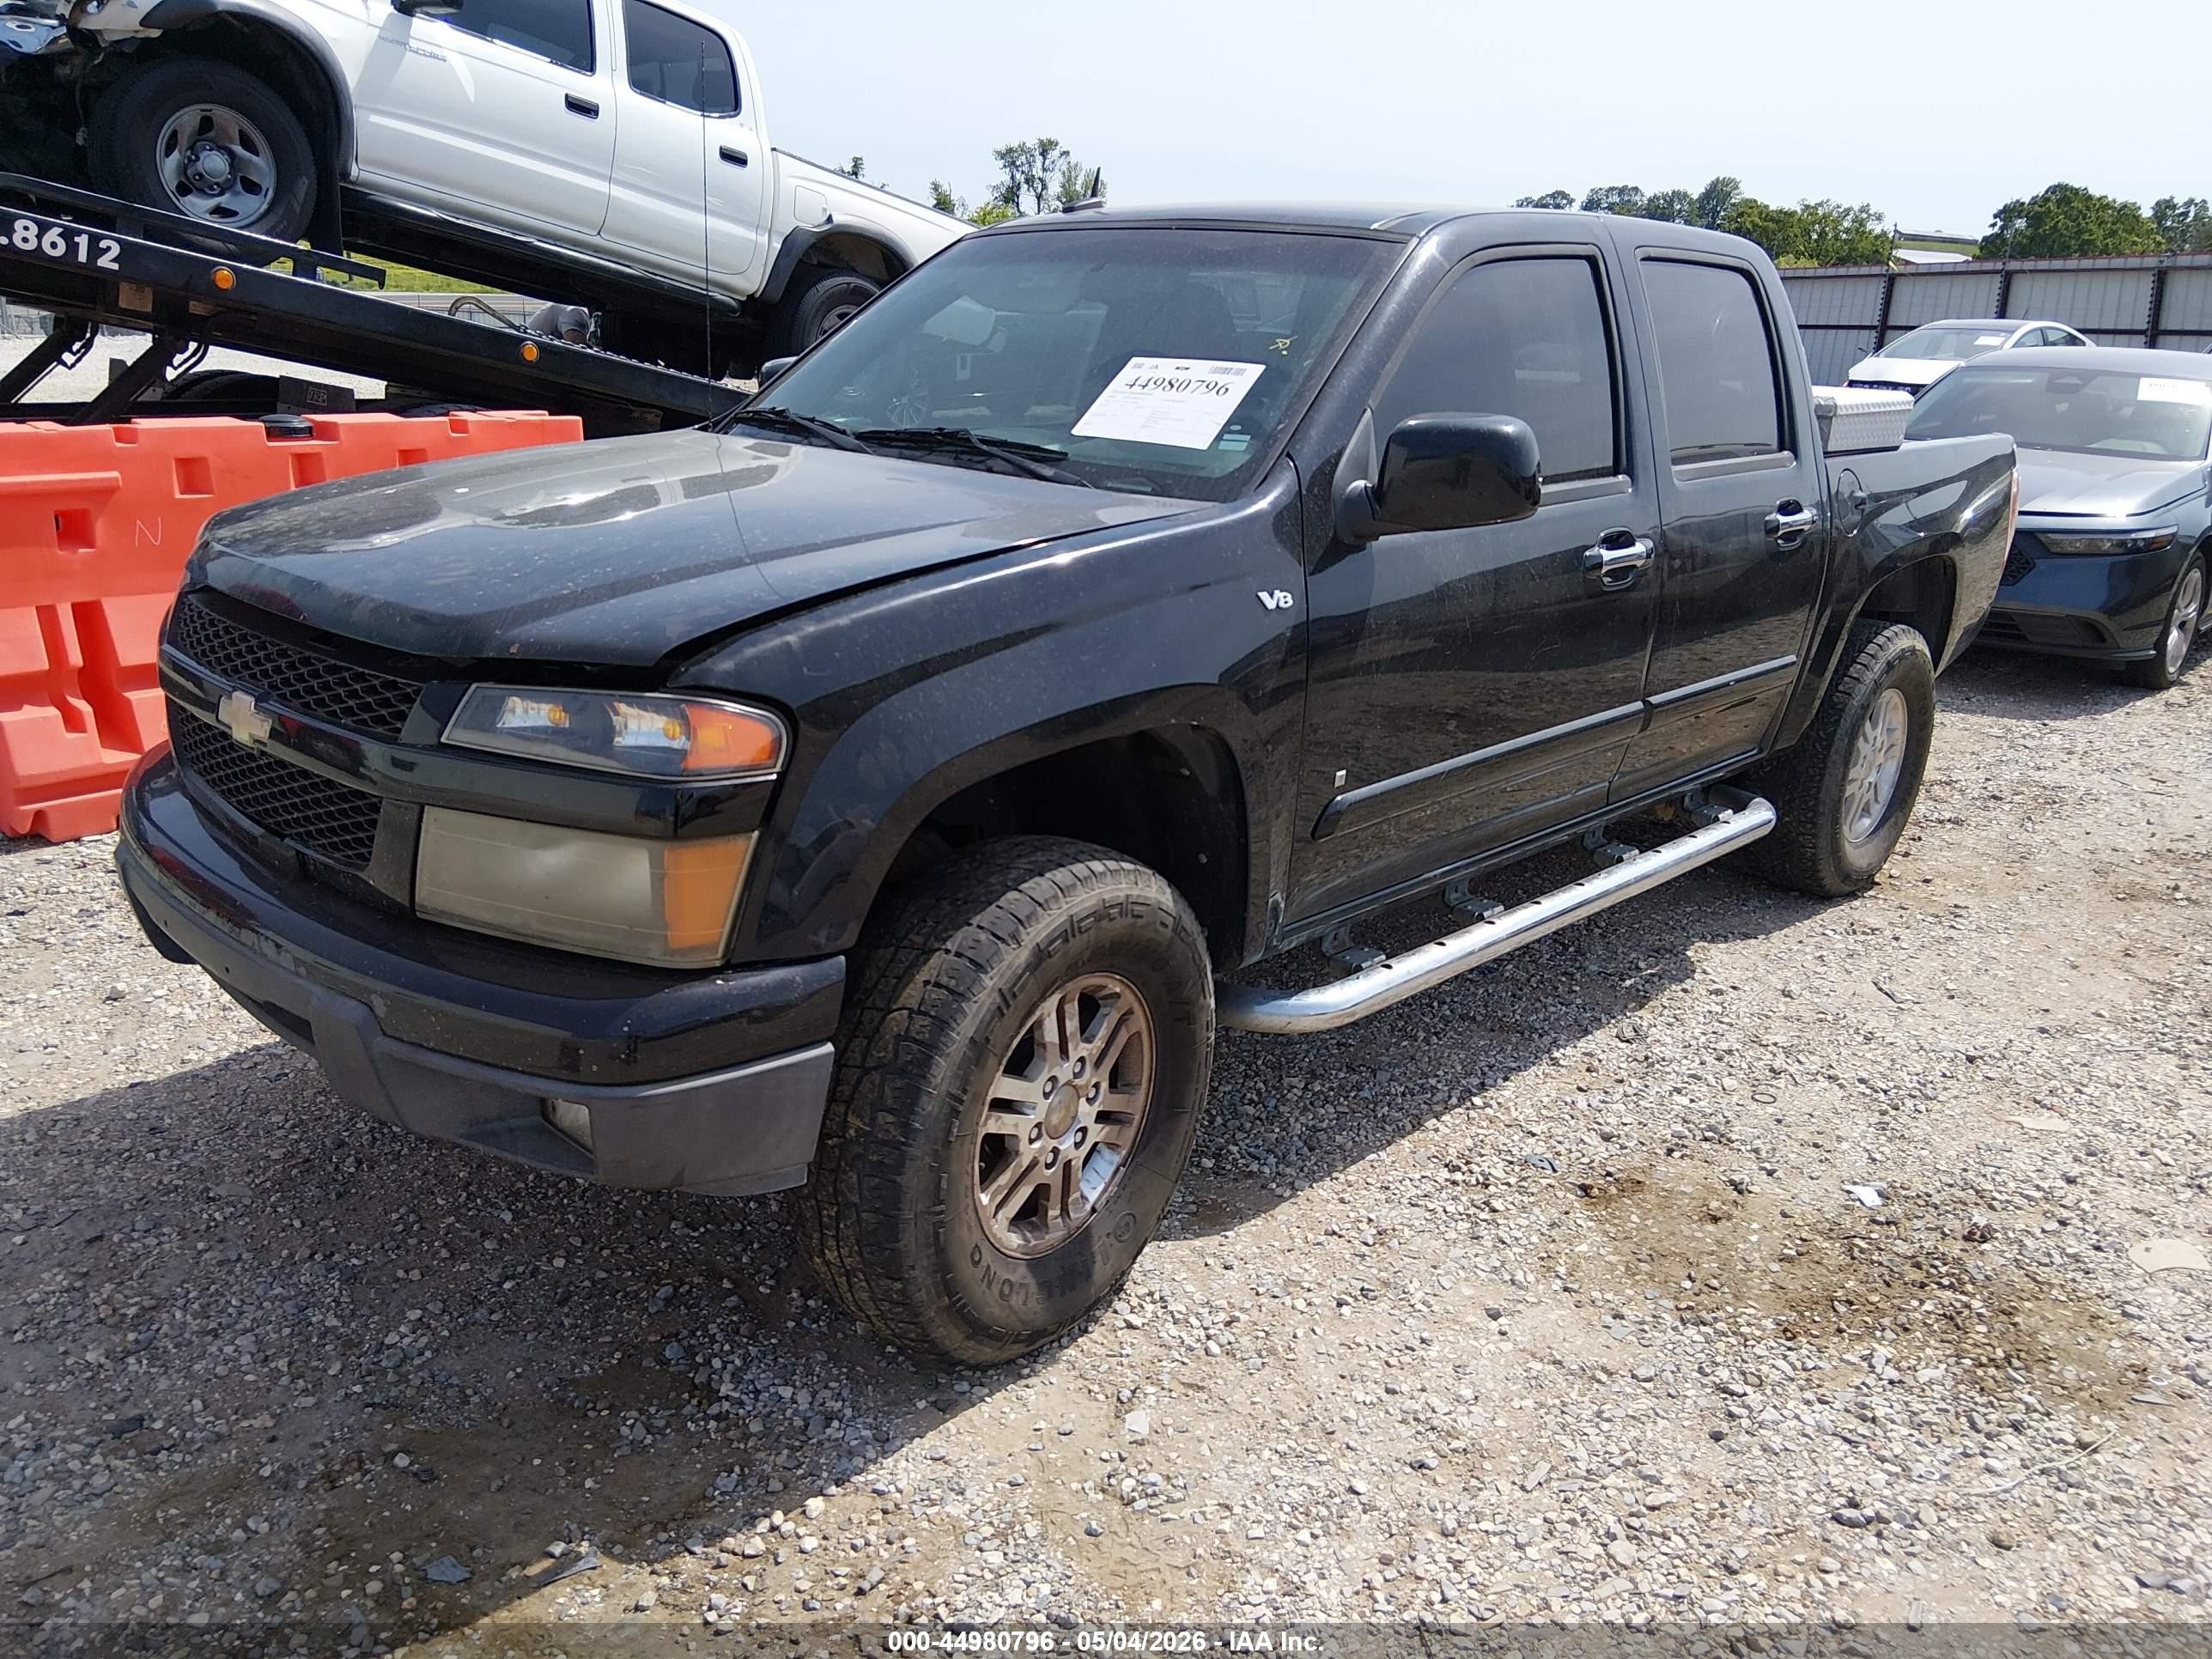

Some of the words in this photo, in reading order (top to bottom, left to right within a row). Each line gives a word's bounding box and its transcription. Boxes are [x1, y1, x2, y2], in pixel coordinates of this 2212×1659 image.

[1125, 375, 1235, 397] 44980796
[136, 516, 161, 547] N
[1256, 589, 1294, 611] V8
